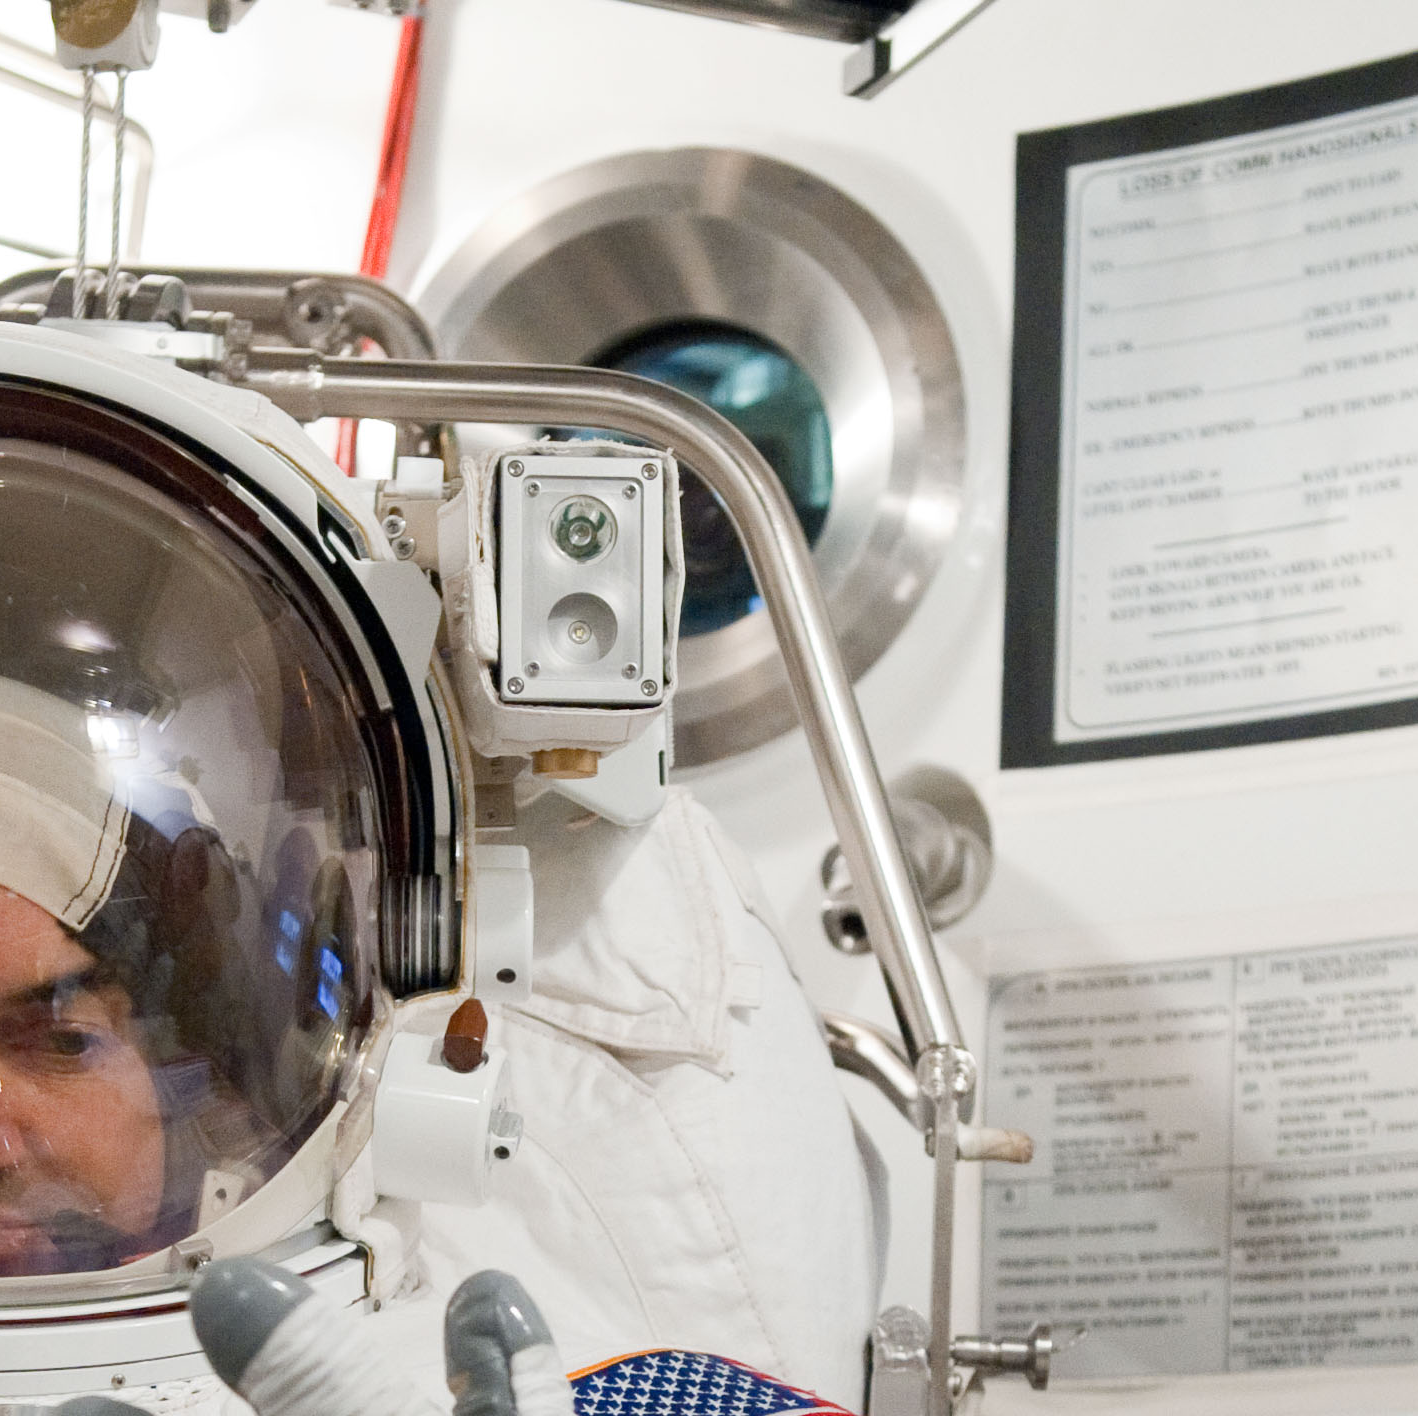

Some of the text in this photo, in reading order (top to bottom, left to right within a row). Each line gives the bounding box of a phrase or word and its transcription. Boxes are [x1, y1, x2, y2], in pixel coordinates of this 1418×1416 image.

[1118, 168, 1172, 197] LOSS
[1178, 162, 1201, 184] OF
[1212, 147, 1273, 177] COMM
